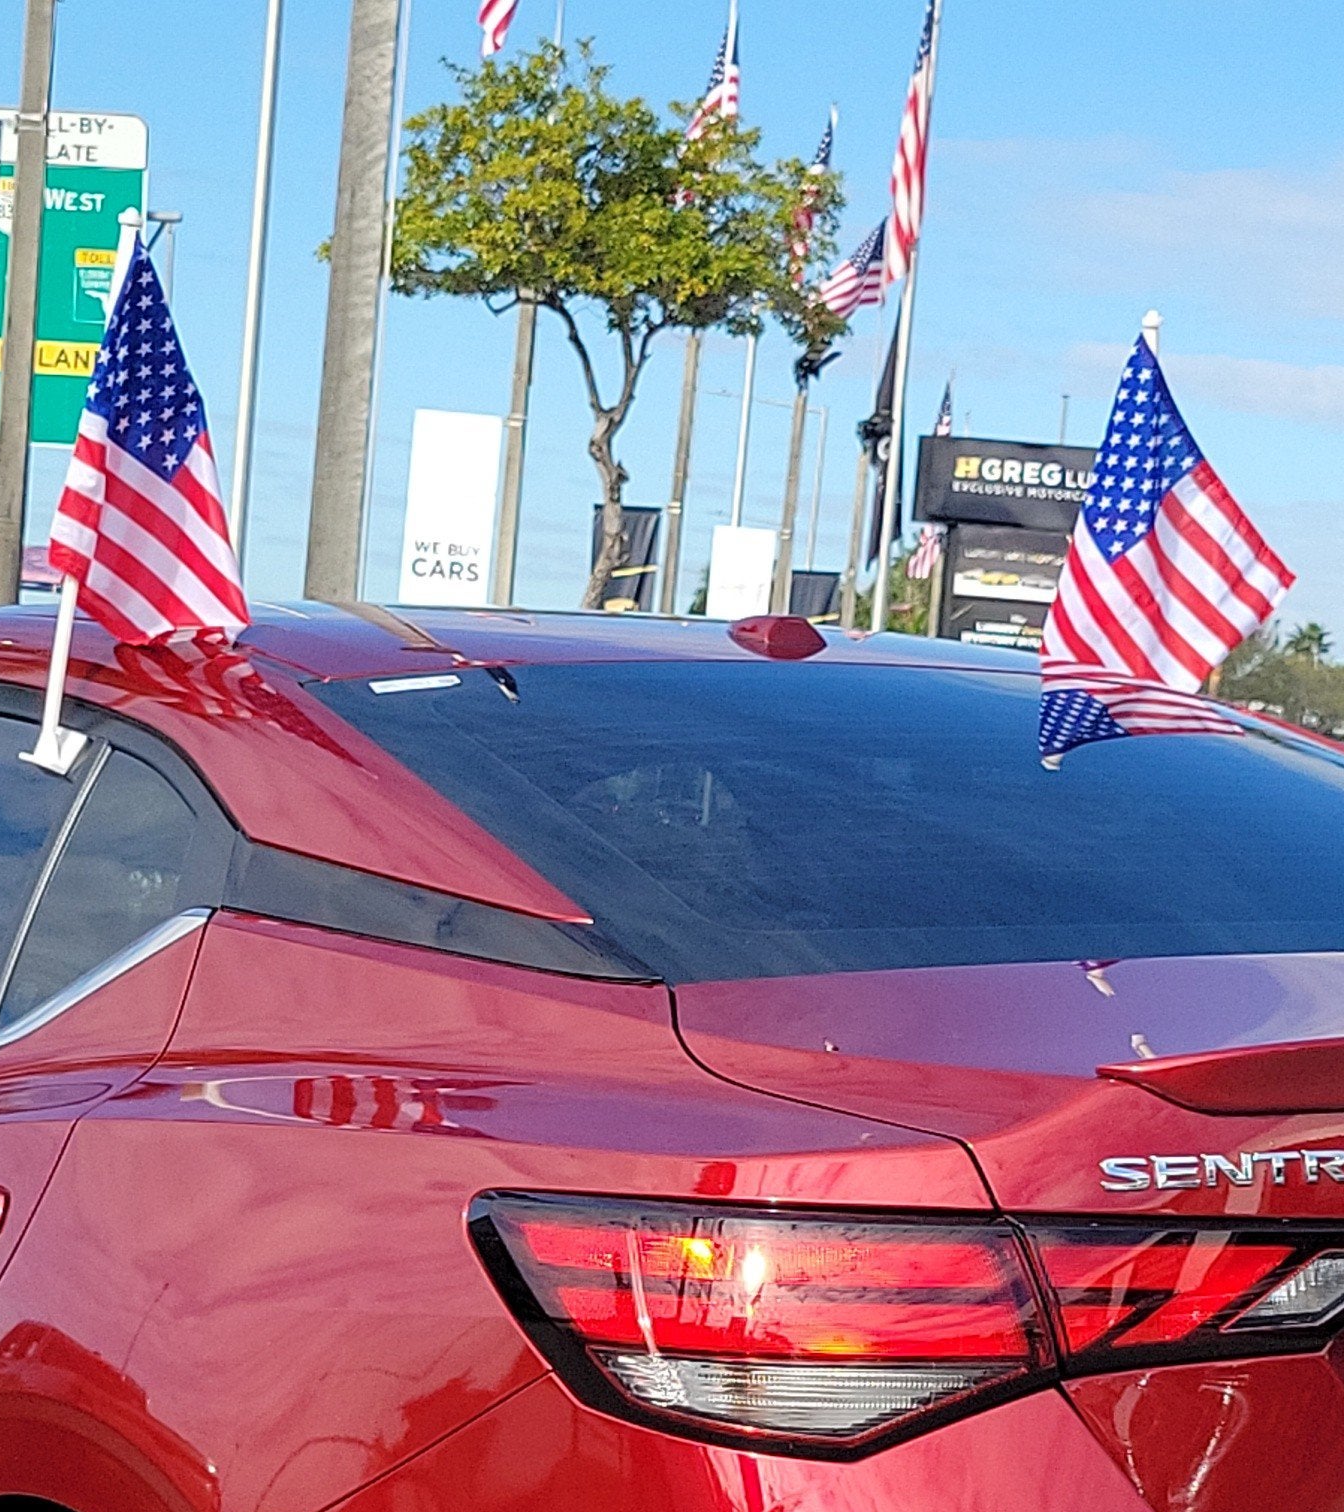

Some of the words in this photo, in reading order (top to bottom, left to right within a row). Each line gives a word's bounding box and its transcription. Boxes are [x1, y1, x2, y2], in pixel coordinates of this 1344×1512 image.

[44, 188, 106, 212] WEST
[447, 543, 481, 556] BUY
[411, 557, 479, 582] CARS
